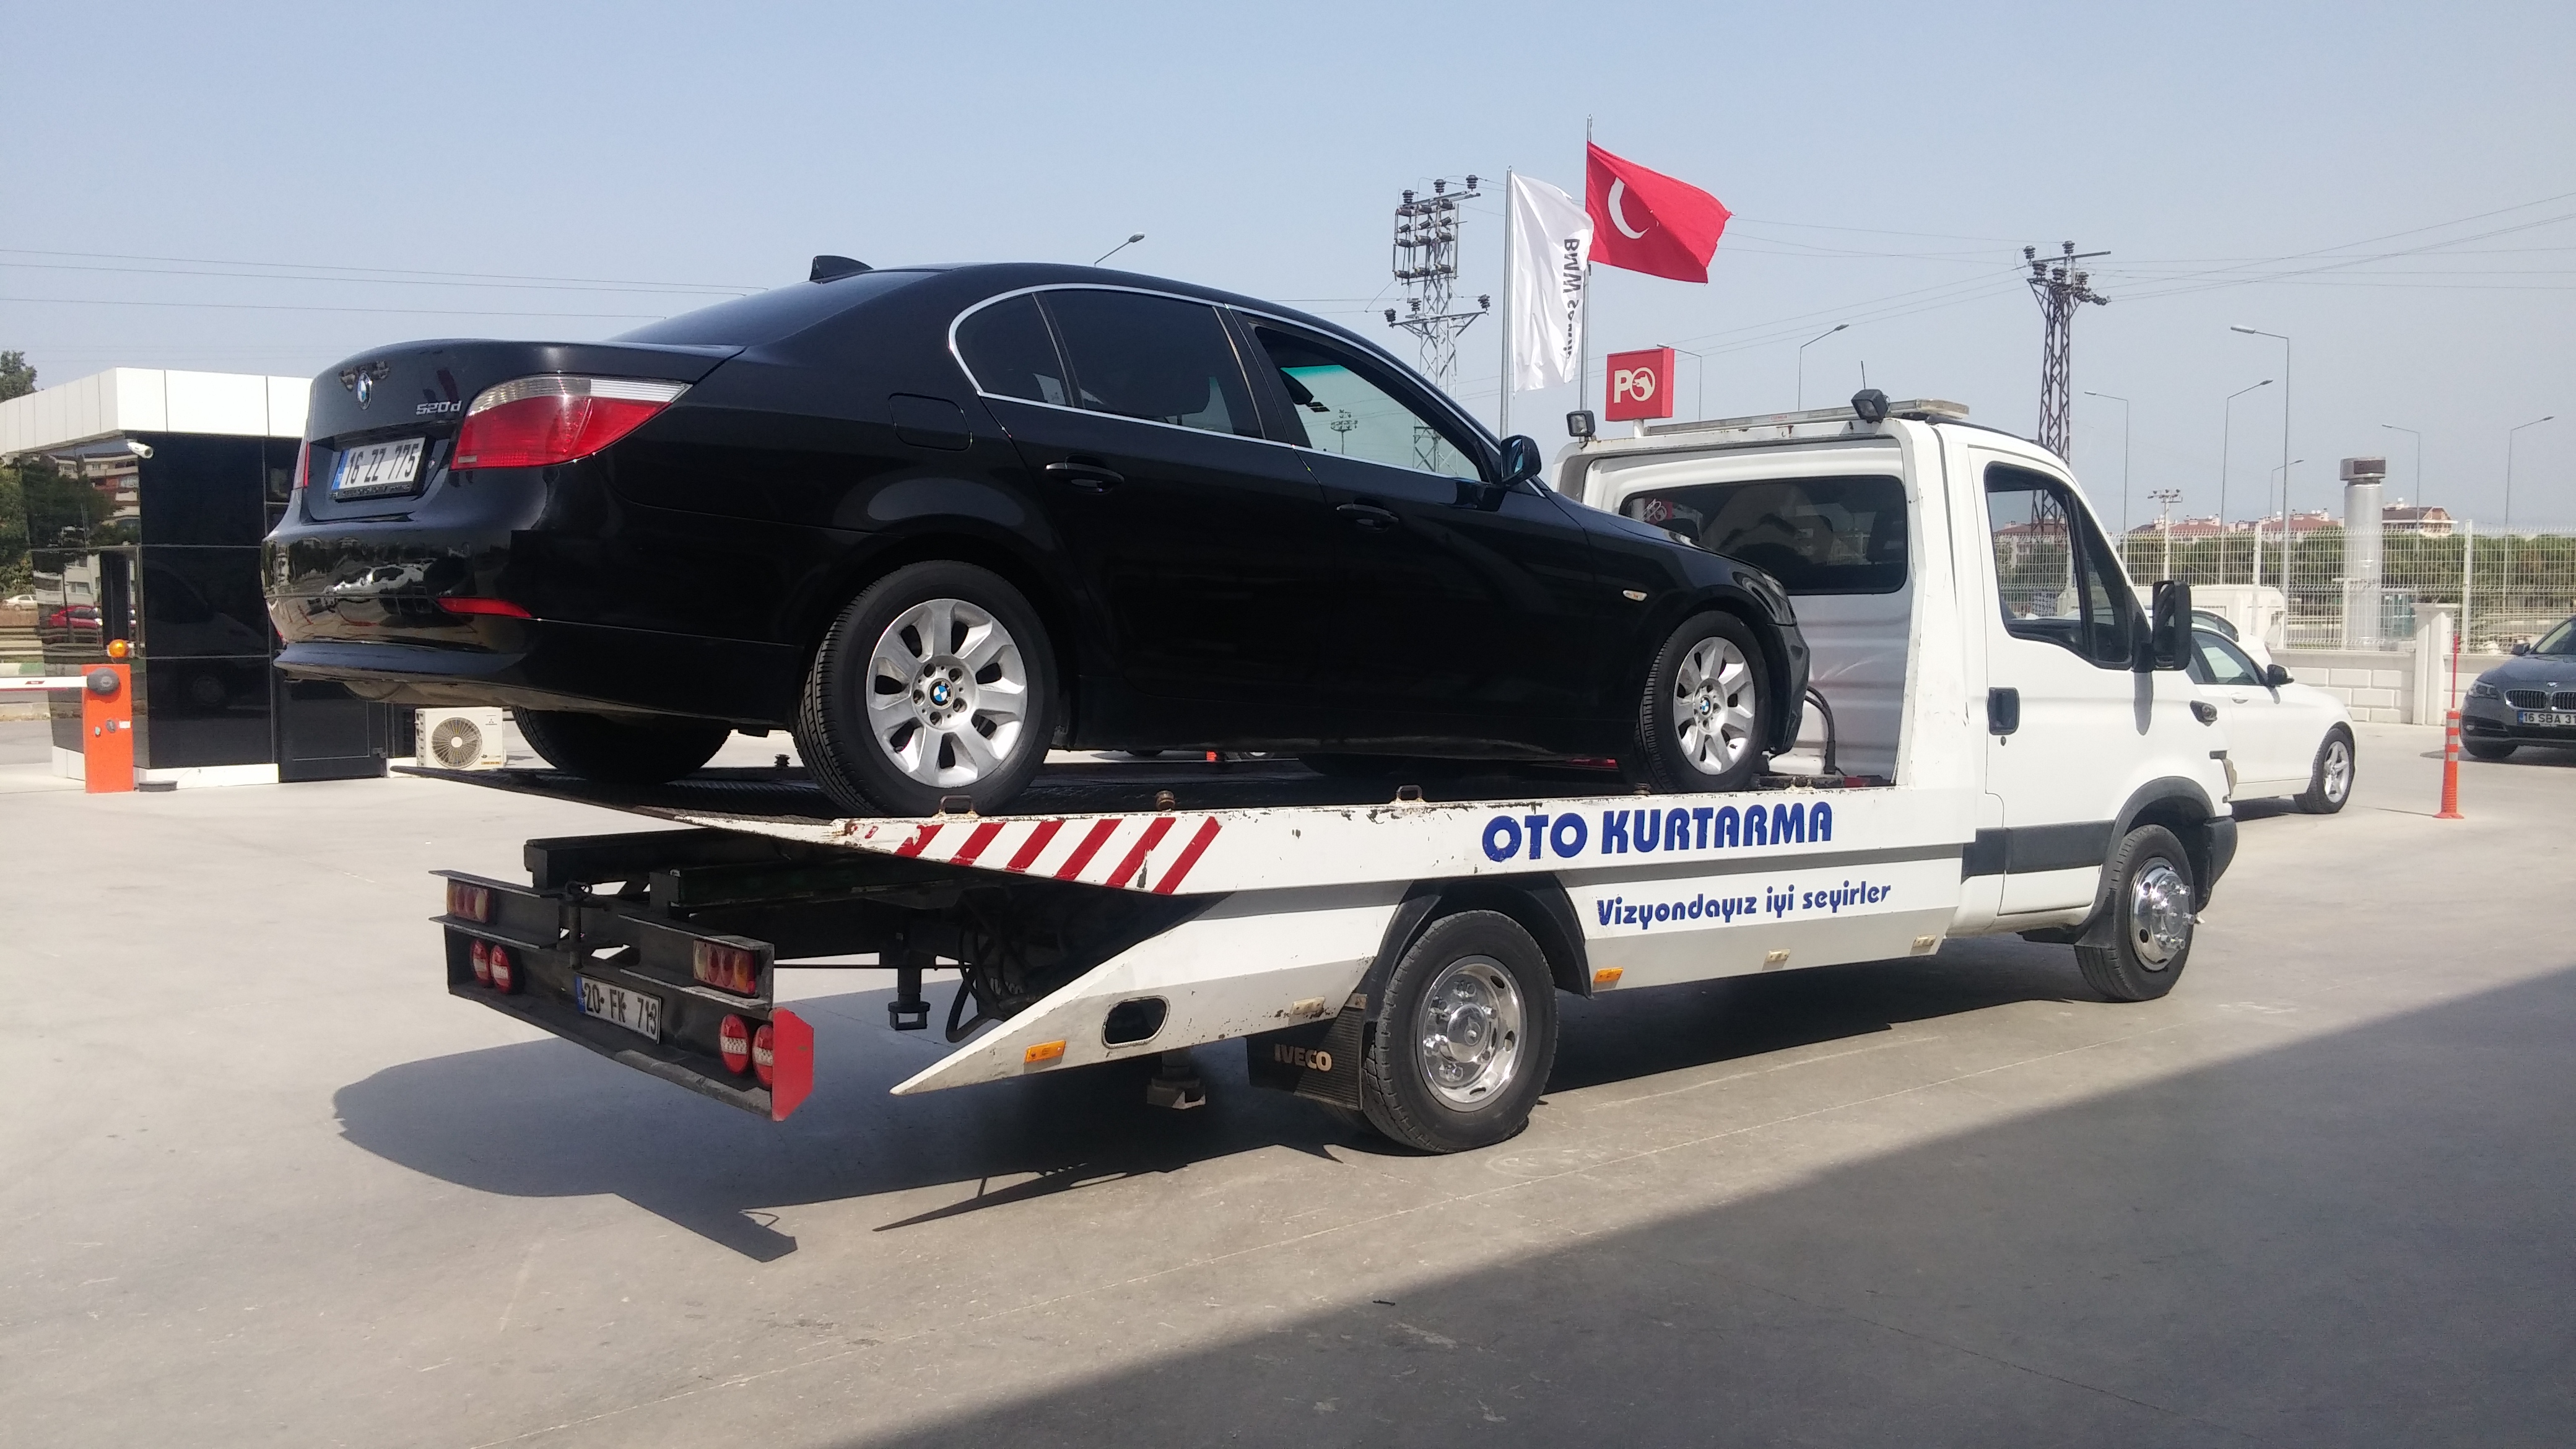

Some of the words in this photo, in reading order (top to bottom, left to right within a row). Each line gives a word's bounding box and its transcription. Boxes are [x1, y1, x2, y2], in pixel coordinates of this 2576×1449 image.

[1613, 366, 1656, 404] PO
[416, 400, 462, 415] 520d
[345, 451, 364, 485] 16
[363, 447, 387, 483] ZZ
[387, 443, 419, 480] 775
[2524, 713, 2535, 722] 16
[2538, 713, 2561, 724] SBA
[1482, 814, 1588, 862] OTO
[1601, 802, 1833, 855] KURTARMA
[1597, 894, 1757, 929] Vizyondayız
[1767, 884, 1795, 918] iyi
[1803, 880, 1891, 913] seyirler
[584, 982, 600, 1014] 20
[609, 988, 625, 1023] FK
[637, 997, 658, 1035] 713
[1274, 1043, 1332, 1071] IVECO
